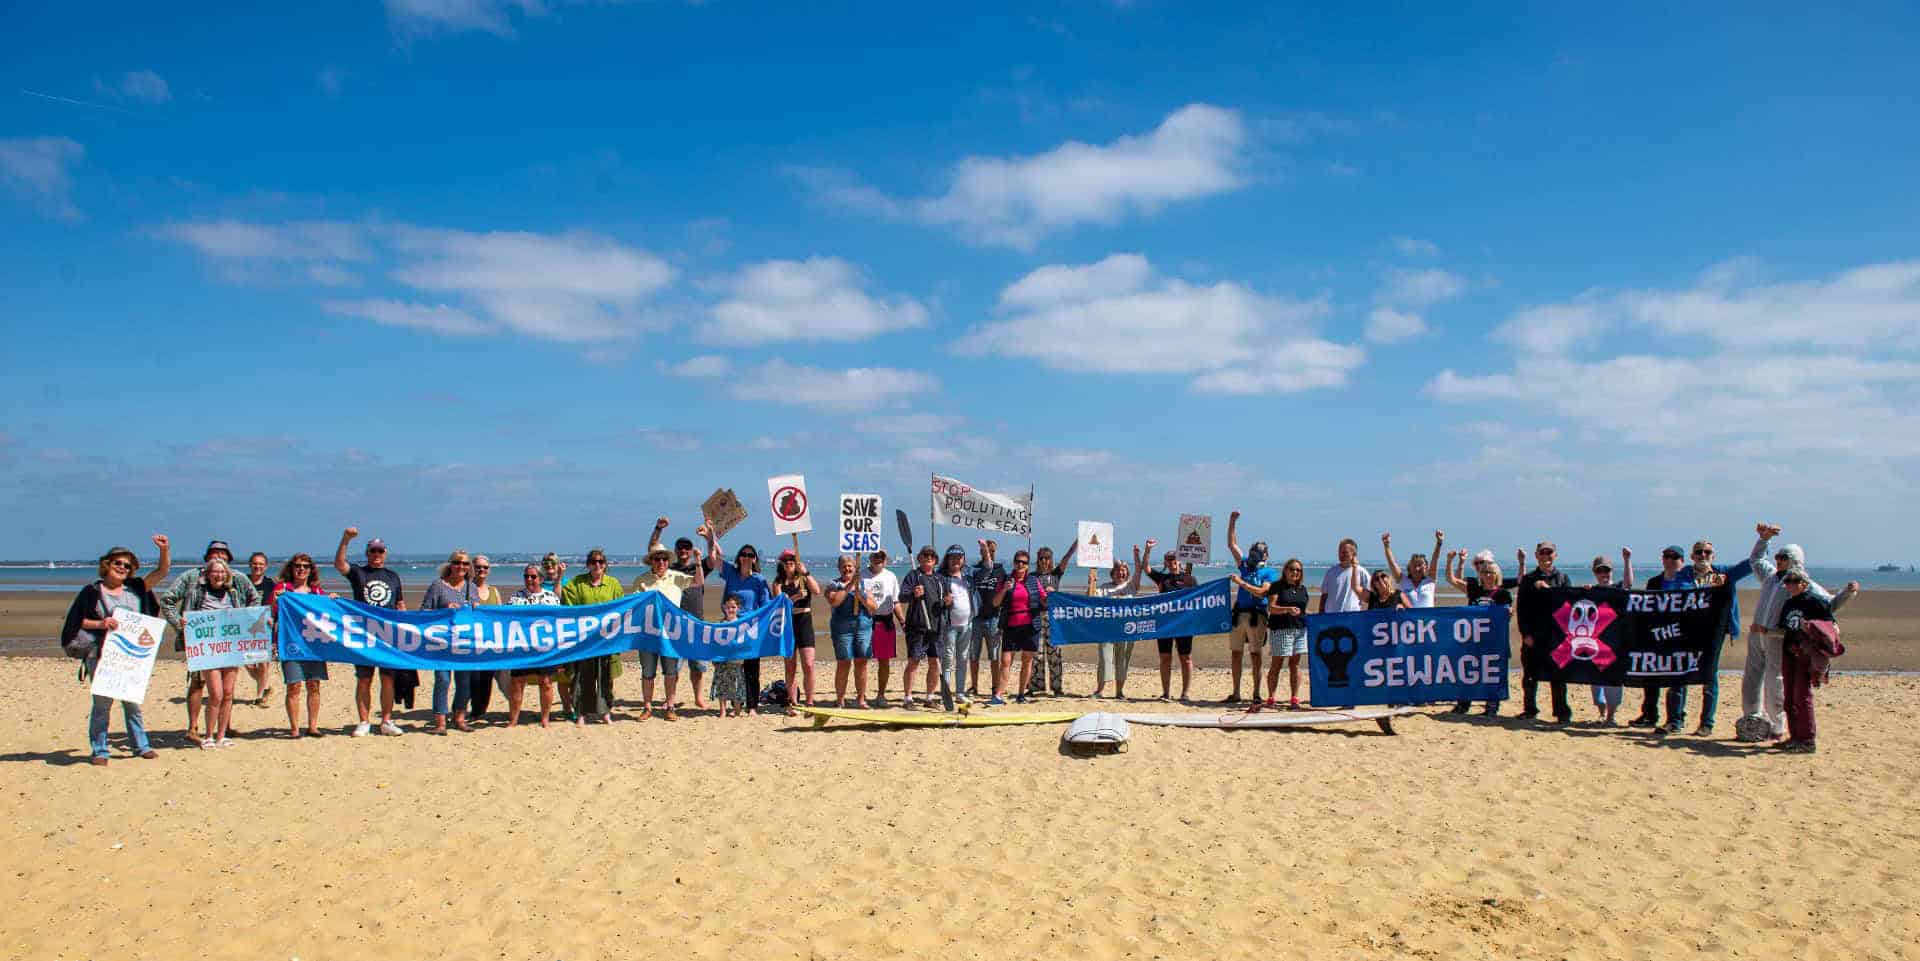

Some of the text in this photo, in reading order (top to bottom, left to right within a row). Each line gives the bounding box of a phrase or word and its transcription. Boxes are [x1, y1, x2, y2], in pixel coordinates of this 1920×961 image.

[932, 479, 972, 496] STOP
[842, 498, 878, 517] SAVE
[843, 517, 873, 532] OUR
[951, 513, 1027, 534] OUR SEAS
[841, 532, 880, 551] SEAS
[1052, 595, 1226, 620] #ENDSEWAGEPOLLUTION
[1627, 592, 1712, 612] REVEAL
[301, 603, 759, 656] #ENDSEWAGEPOLLUTION
[1371, 617, 1491, 647] SICK OF
[1650, 622, 1681, 642] THE
[1363, 653, 1502, 688] SEWAGE
